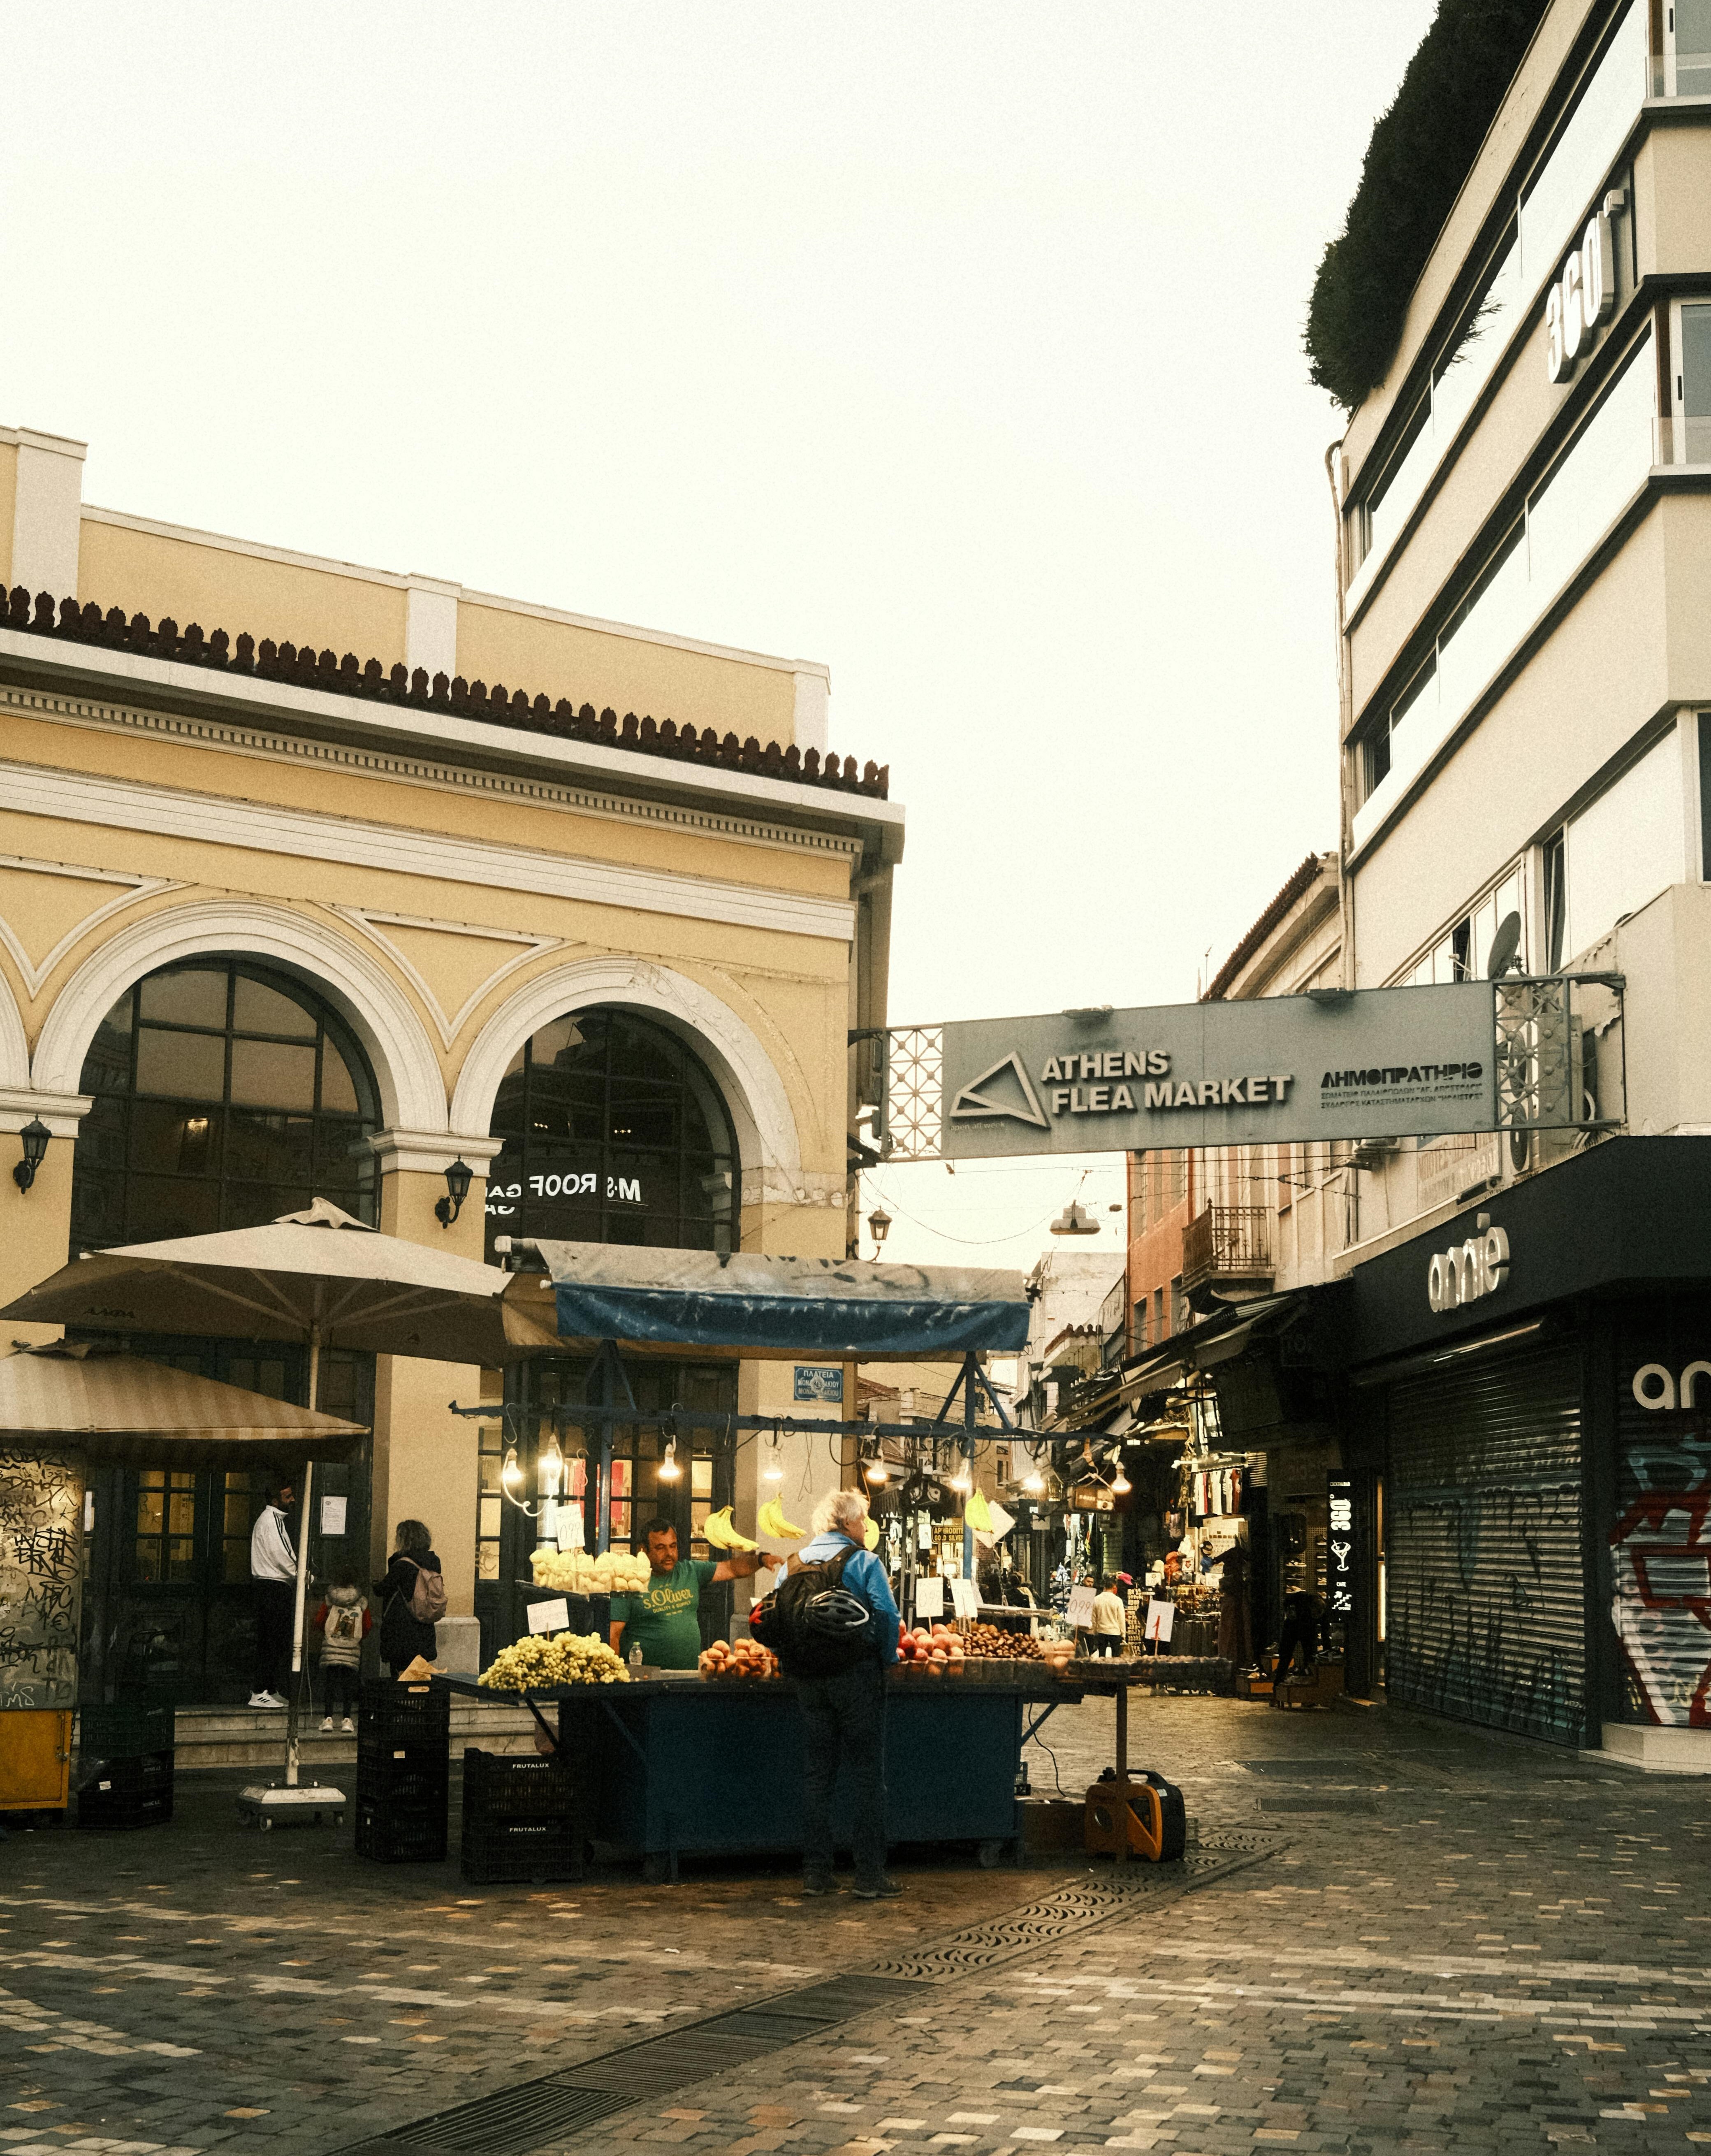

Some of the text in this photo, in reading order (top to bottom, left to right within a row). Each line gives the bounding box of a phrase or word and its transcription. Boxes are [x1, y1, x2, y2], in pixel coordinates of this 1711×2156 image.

[1040, 1050, 1168, 1081] ATHENS
[1052, 1075, 1291, 1114] FLEA MARKET
[804, 1370, 834, 1378] ΠΛΑΤΕΙΑ
[643, 1588, 693, 1609] s.Oliver
